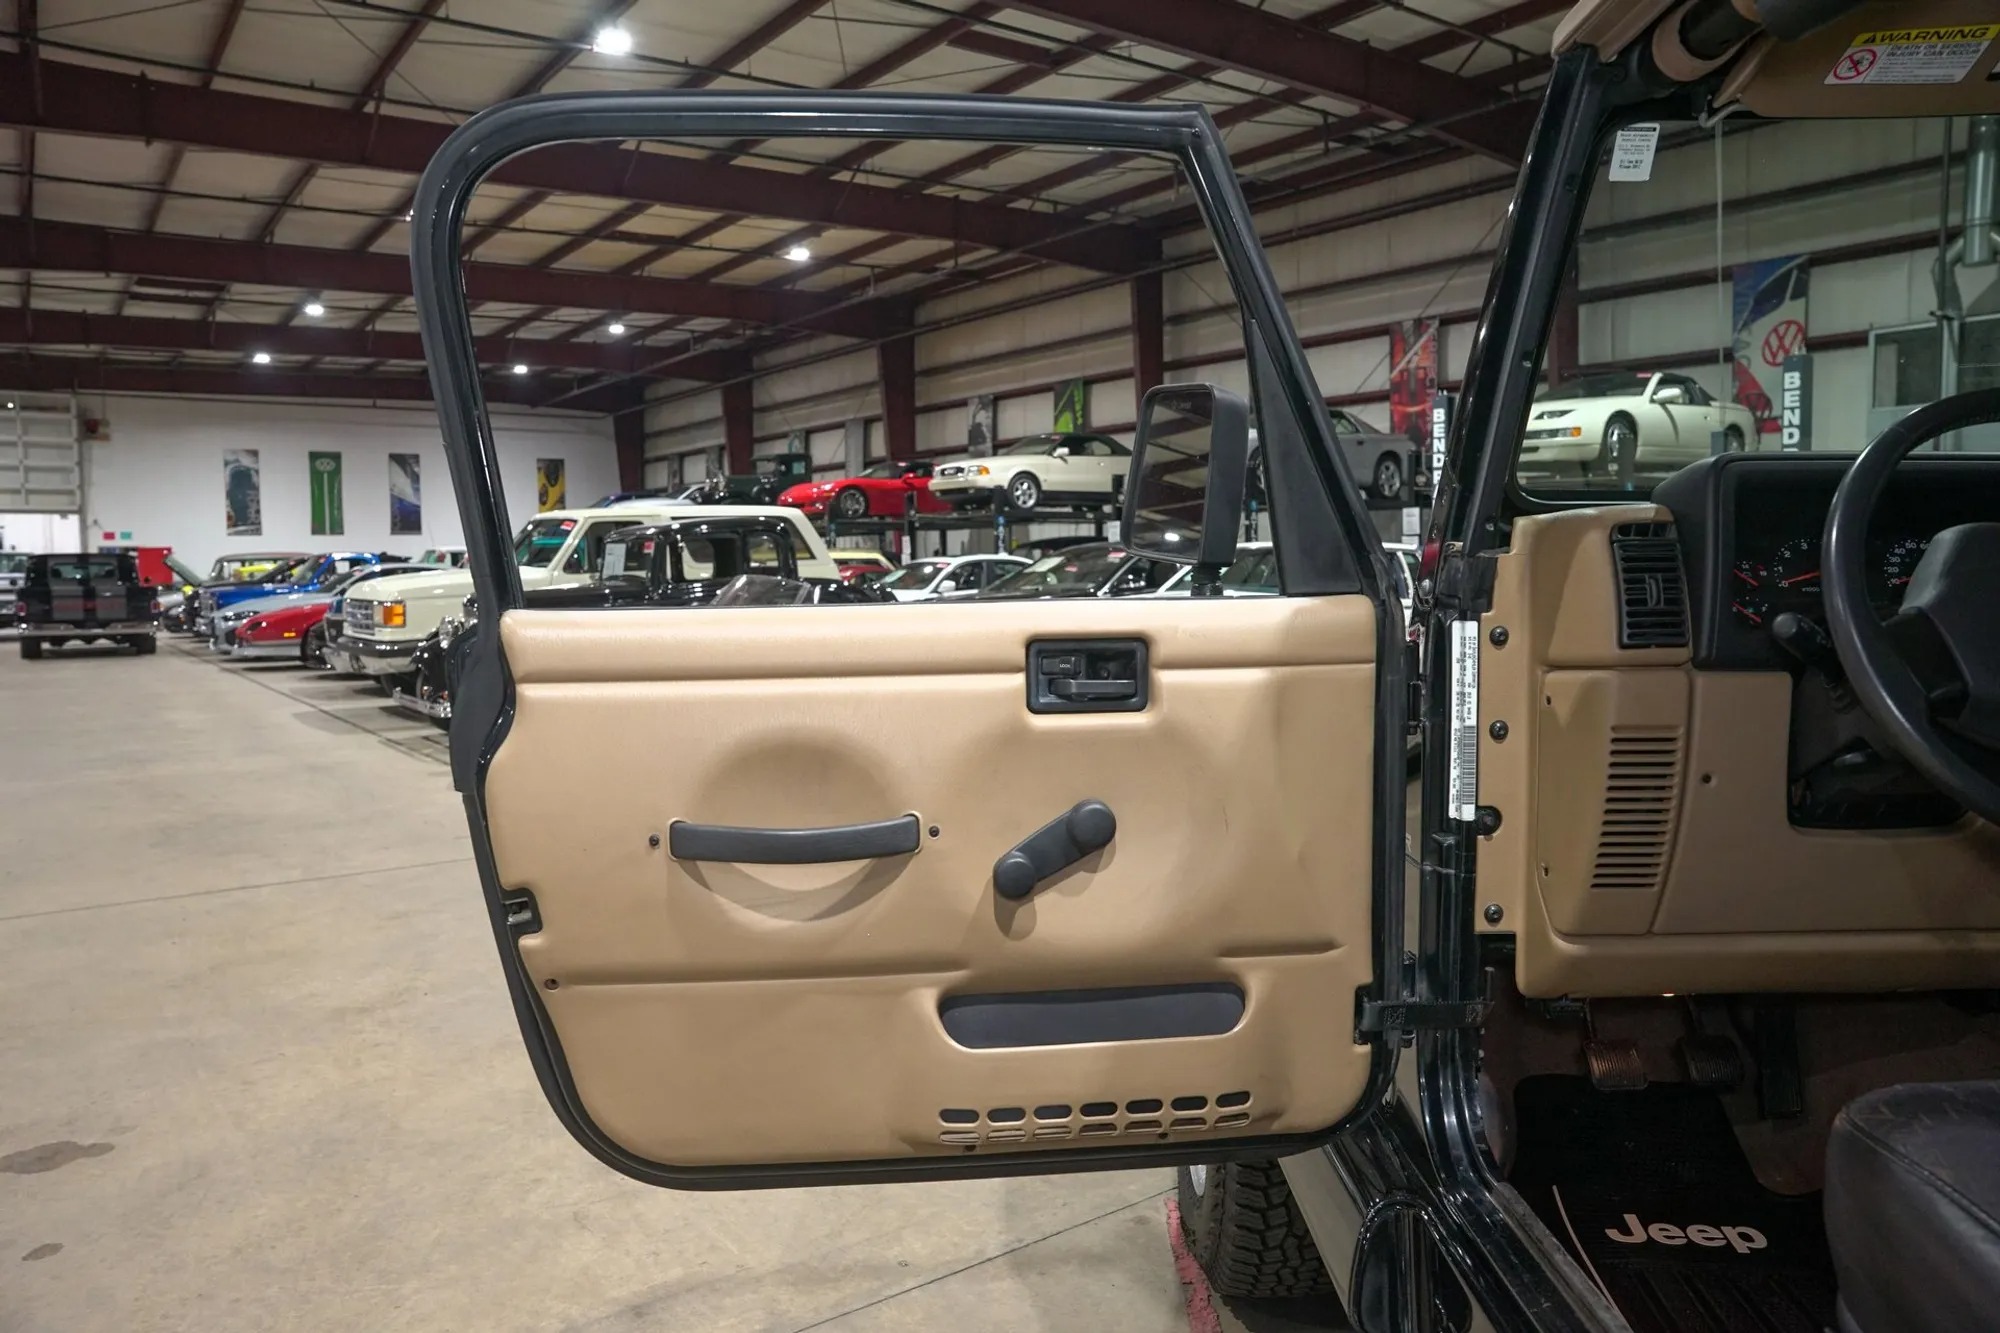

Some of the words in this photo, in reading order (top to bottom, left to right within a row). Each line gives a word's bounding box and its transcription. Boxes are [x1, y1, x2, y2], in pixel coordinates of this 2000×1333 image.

[1881, 27, 1989, 42] WARNING
[1923, 49, 1944, 57] CAN
[1782, 371, 1801, 451] BEND
[1432, 408, 1446, 498] BENDP
[1888, 555, 1901, 563] 30
[1604, 1213, 1768, 1254] Jeep
